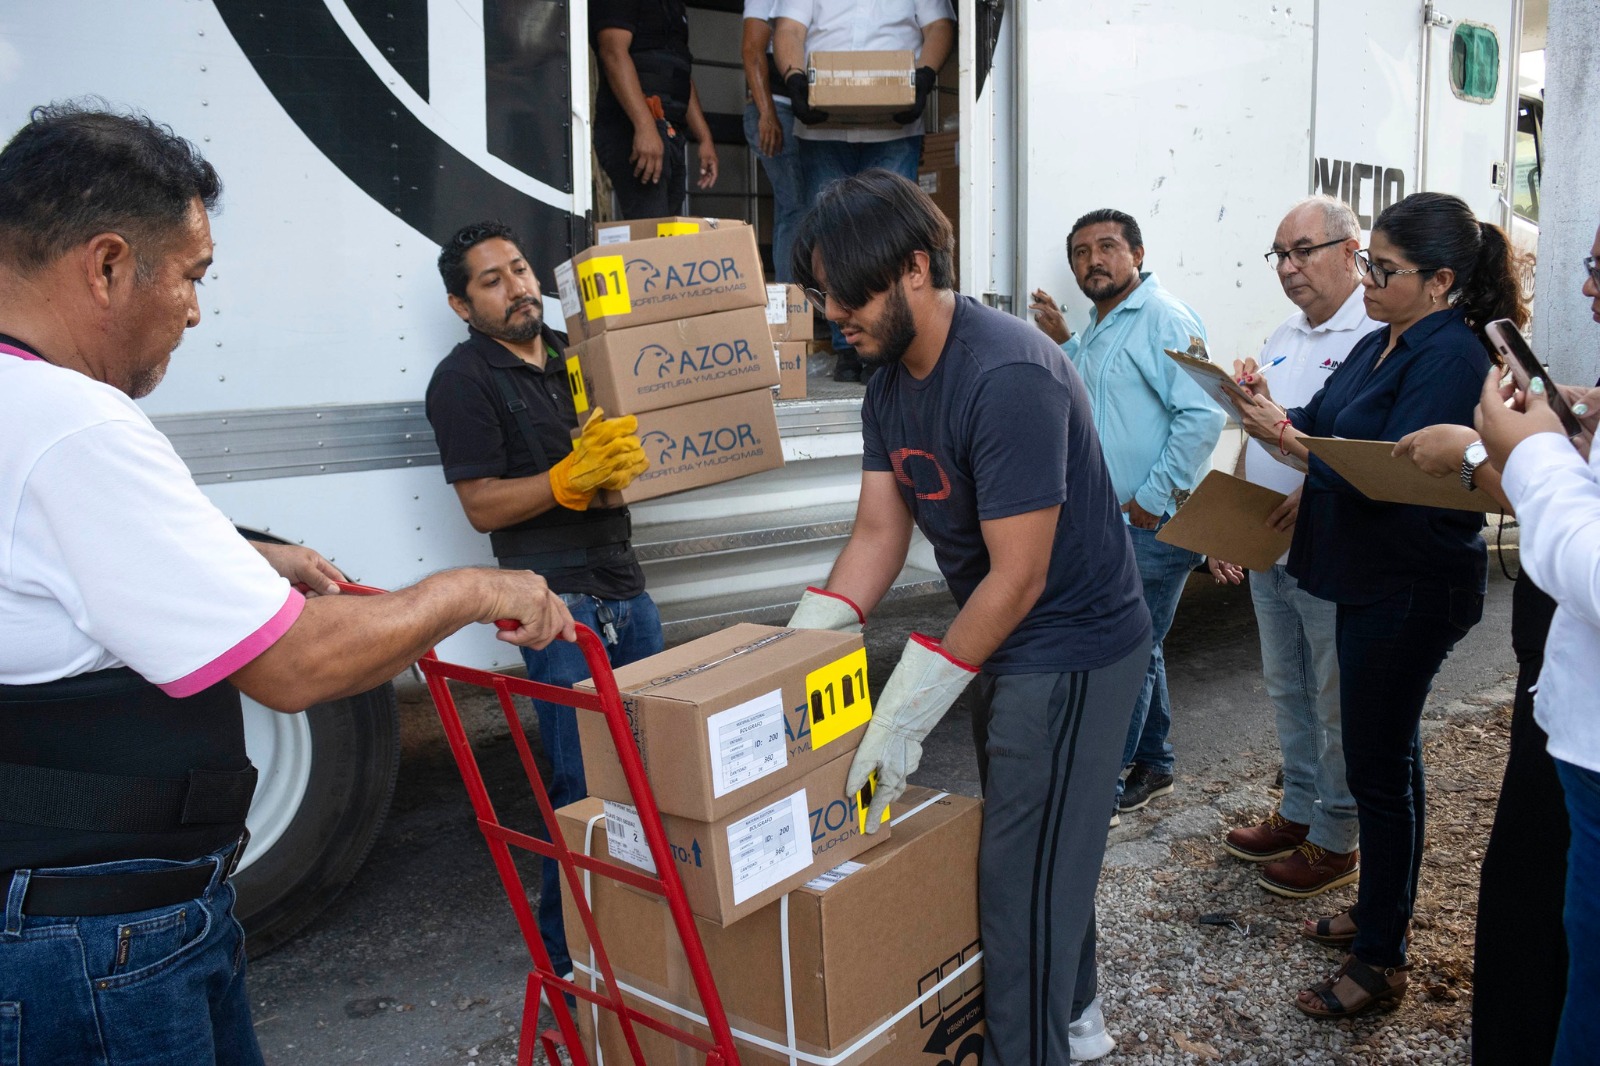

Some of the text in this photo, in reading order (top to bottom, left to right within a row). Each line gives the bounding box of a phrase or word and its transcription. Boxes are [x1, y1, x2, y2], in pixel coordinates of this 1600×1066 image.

[1314, 157, 1404, 230] VICIO
[631, 294, 677, 308] SCRITURA
[687, 285, 724, 298] MUCHO
[724, 282, 747, 293] MAS
[637, 364, 760, 394] ESCRITURA Y MUCHO MAS
[639, 448, 764, 481] ESCRITURA Y MUCHO MAS
[754, 732, 779, 748] ID: 200
[633, 832, 639, 843] 2
[764, 825, 790, 843] ID: 200
